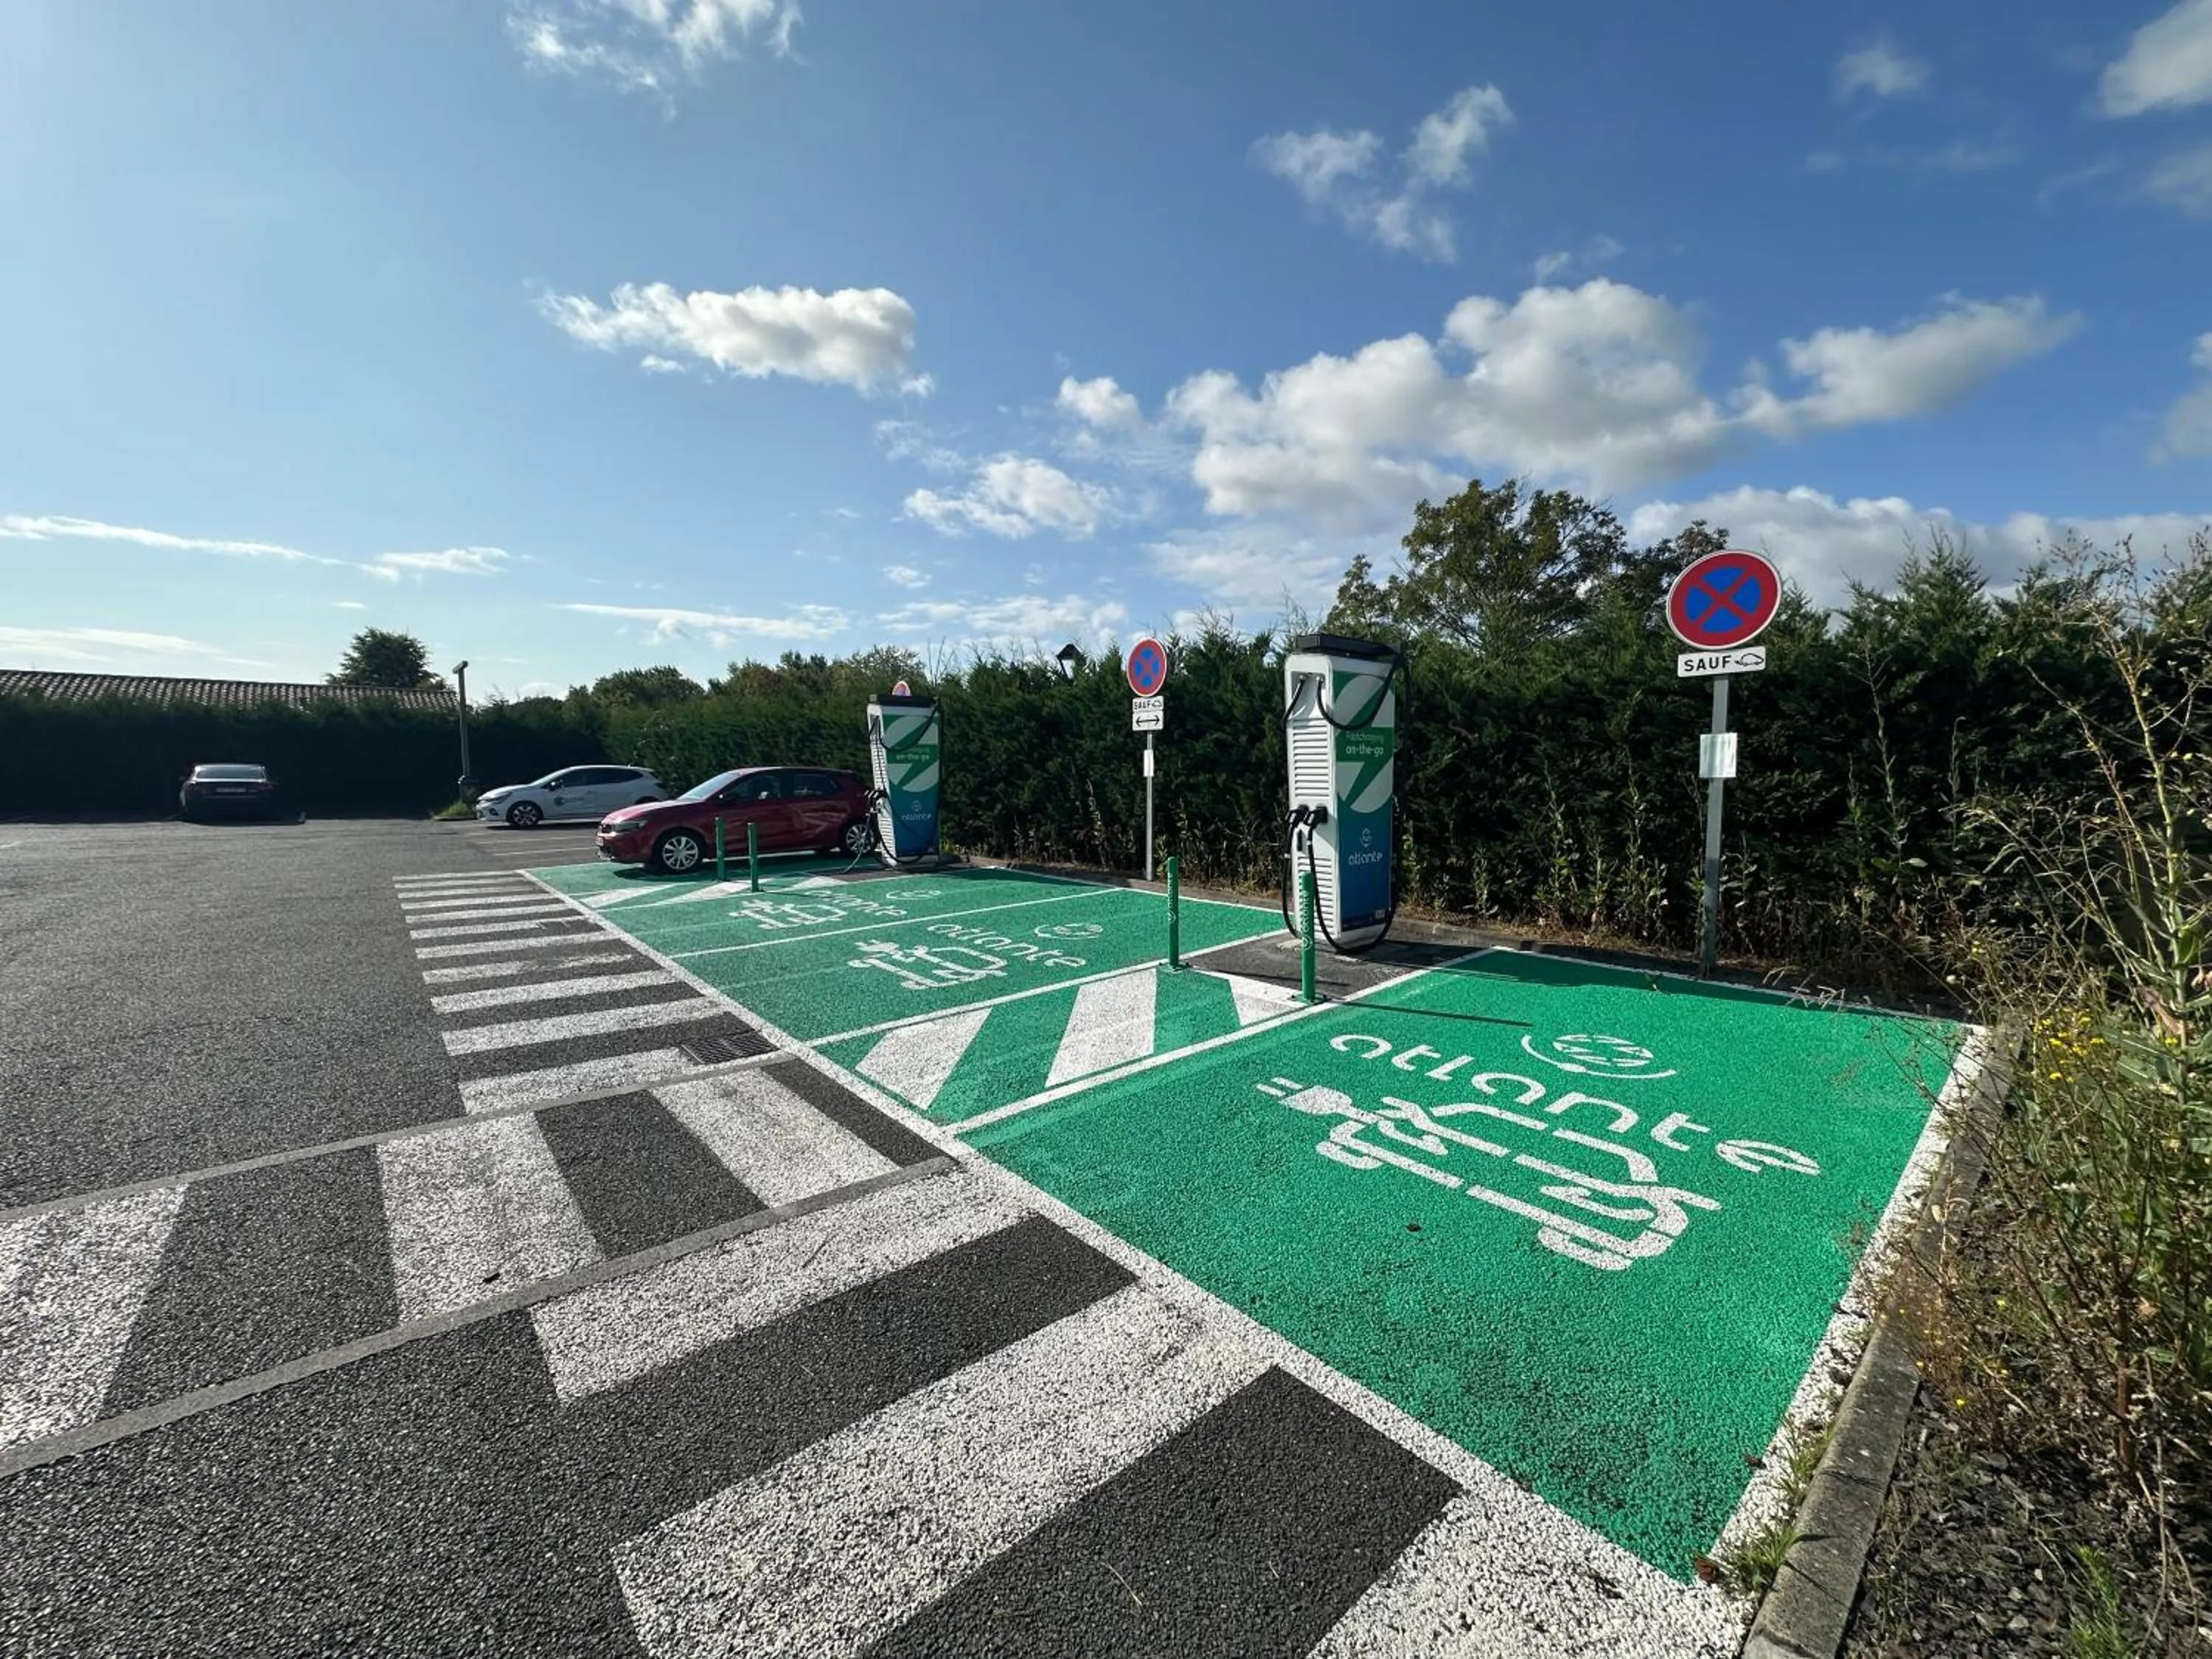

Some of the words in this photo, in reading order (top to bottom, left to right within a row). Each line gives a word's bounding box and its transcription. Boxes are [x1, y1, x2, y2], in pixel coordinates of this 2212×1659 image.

[1684, 655, 1731, 672] SAUF
[1134, 700, 1151, 709] SAUF
[1346, 742, 1384, 757] on-the-go
[1349, 850, 1382, 865] atlante
[926, 923, 1086, 967] atlante
[1329, 1034, 1820, 1176] atlante
